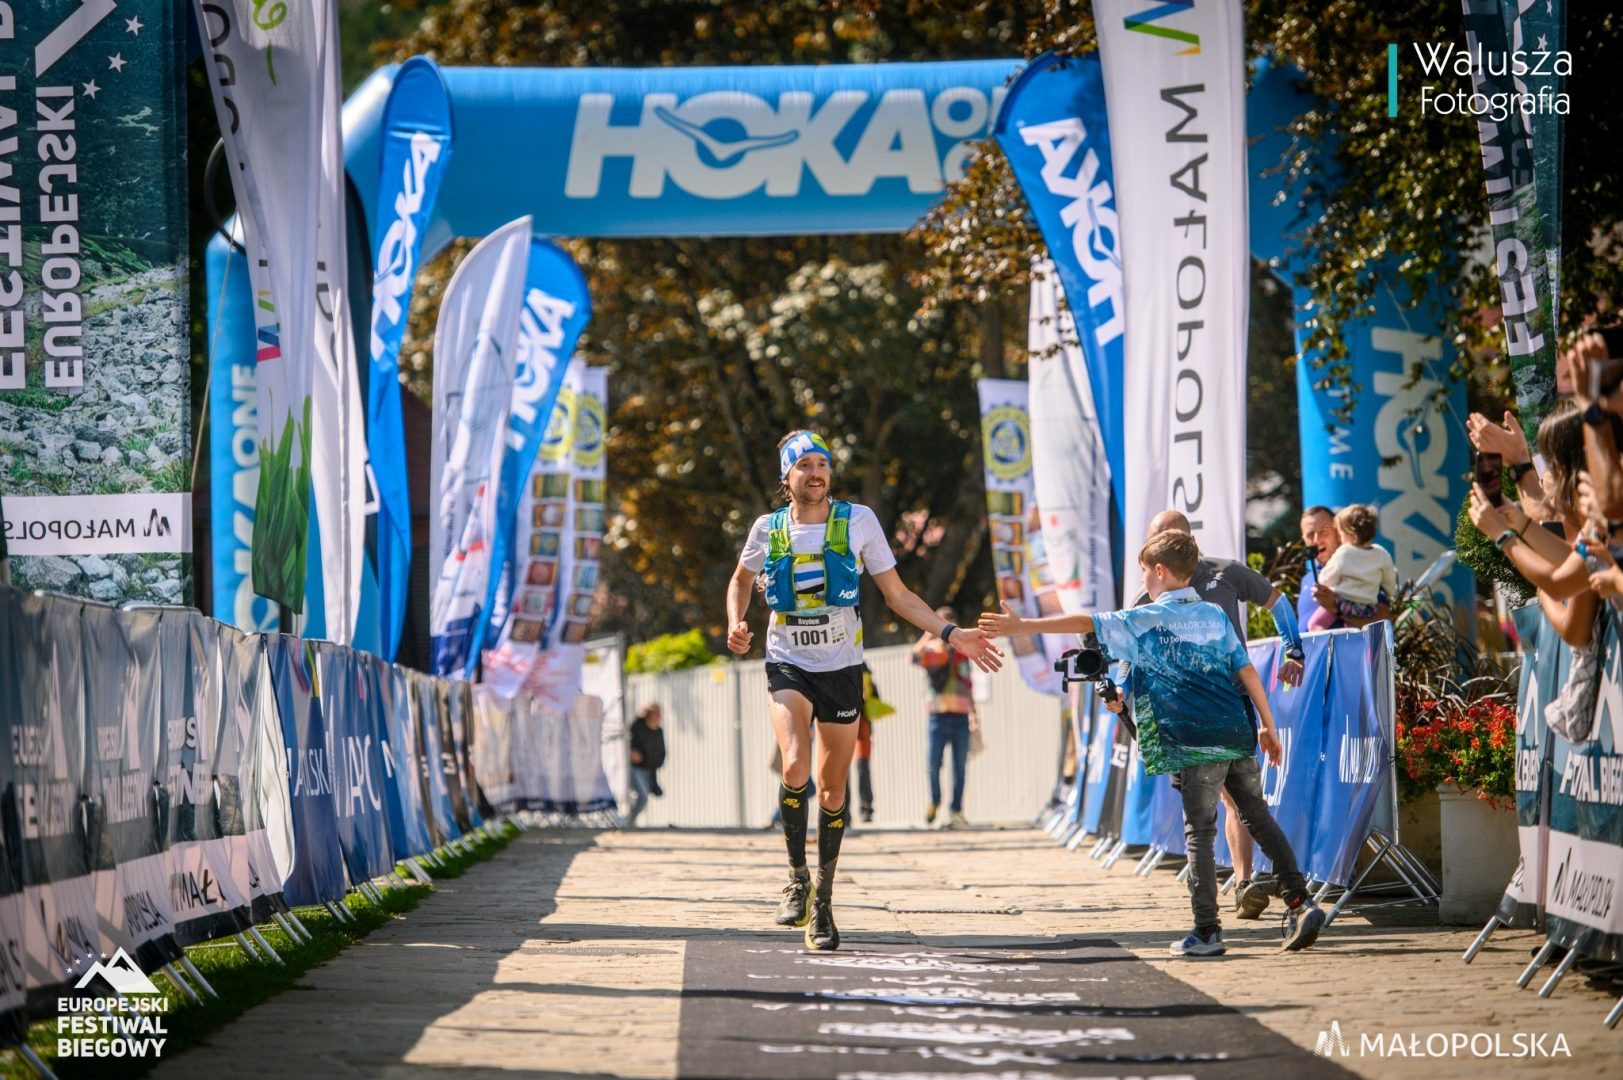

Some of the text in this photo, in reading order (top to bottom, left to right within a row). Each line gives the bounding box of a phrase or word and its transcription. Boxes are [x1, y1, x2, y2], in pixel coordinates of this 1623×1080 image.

[564, 90, 943, 198] HOKA
[1372, 326, 1452, 586] HOKA
[791, 629, 828, 646] 1001
